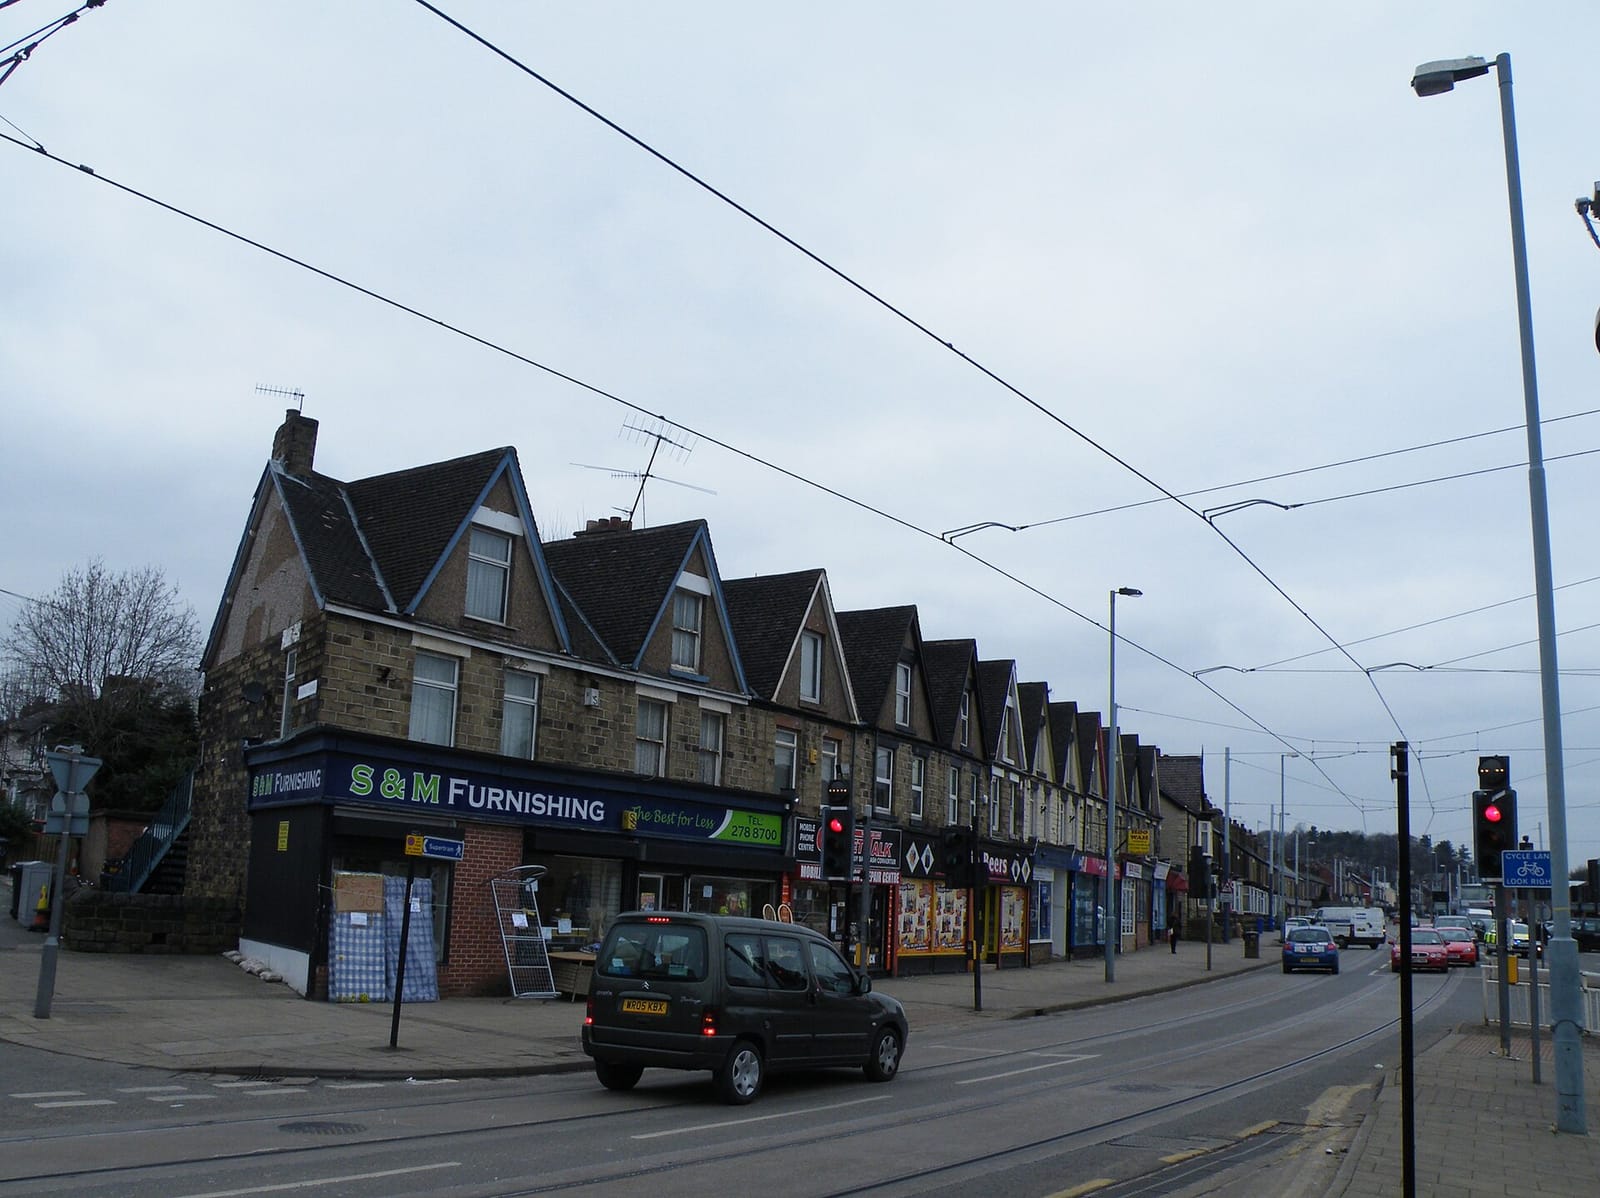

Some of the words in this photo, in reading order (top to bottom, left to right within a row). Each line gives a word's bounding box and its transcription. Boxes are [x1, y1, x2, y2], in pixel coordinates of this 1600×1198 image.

[274, 769, 322, 793] FURNISHING
[448, 778, 605, 822] FURNISHING
[654, 809, 677, 825] Best
[677, 810, 694, 828] for
[695, 813, 715, 830] Less
[752, 827, 777, 841] 8700
[428, 842, 455, 853] Supertram
[798, 842, 814, 852] CENTRE
[1505, 852, 1531, 860] CYCLE
